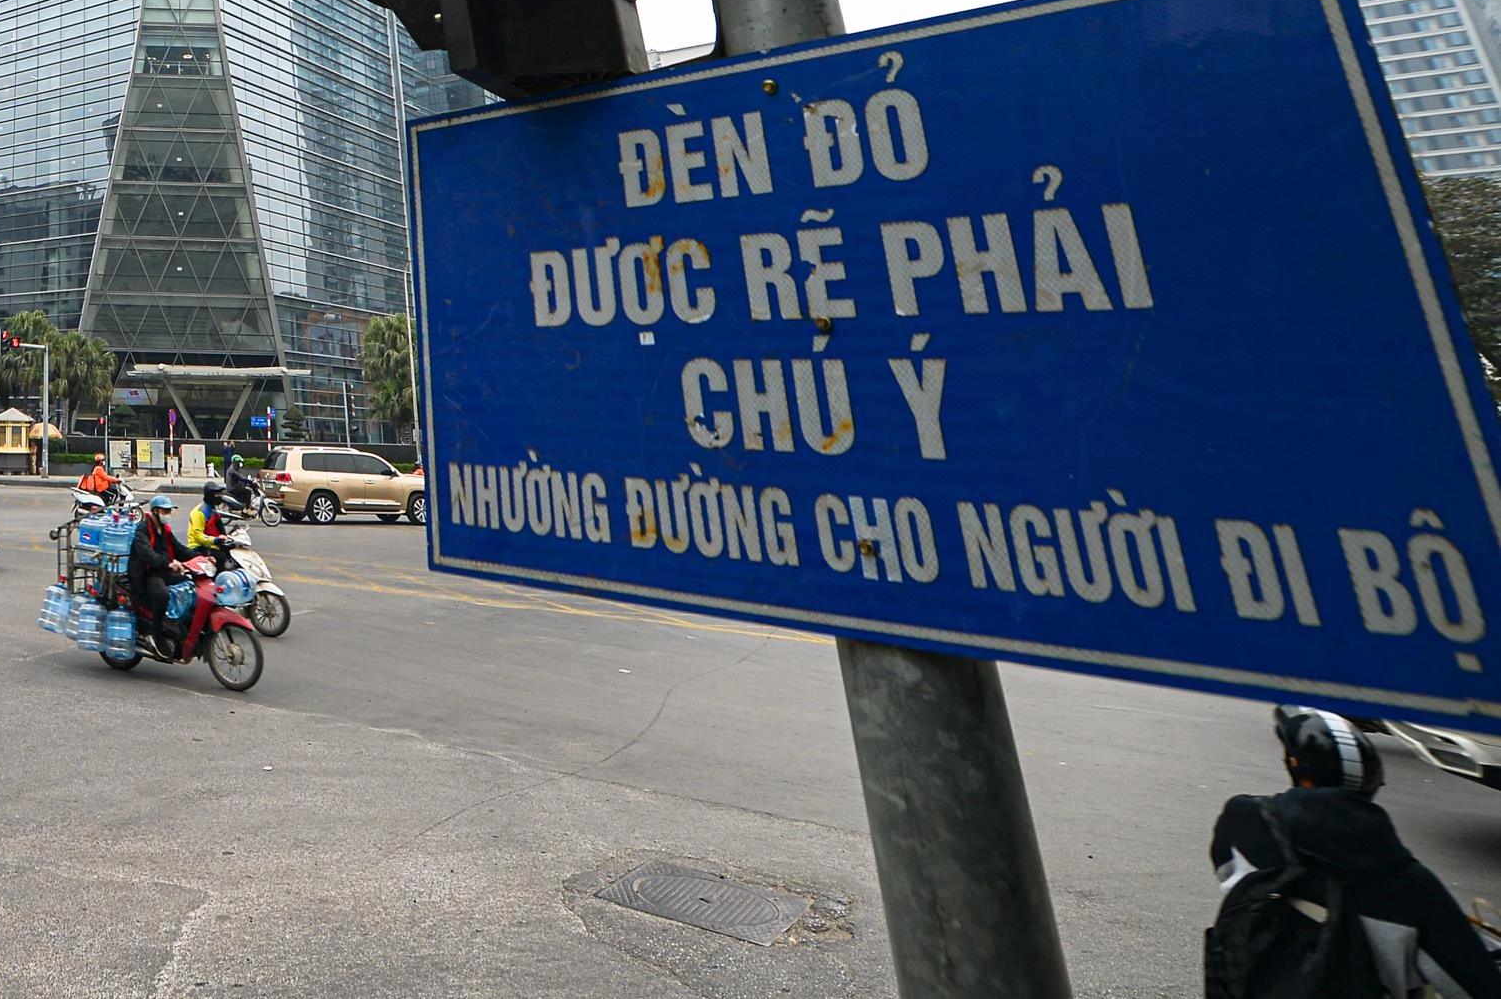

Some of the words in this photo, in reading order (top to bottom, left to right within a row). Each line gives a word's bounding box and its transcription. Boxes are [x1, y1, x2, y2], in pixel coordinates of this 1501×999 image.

[617, 103, 774, 209] ĐÈN
[801, 50, 929, 190] ĐỎ
[528, 232, 717, 346] ĐƯỢC
[740, 207, 857, 321] RẼ
[880, 164, 1154, 318] PHẢI
[680, 334, 856, 457] CHÚ
[889, 332, 948, 461] Ý
[448, 447, 611, 546] NHƯỜNG
[624, 461, 798, 568] ĐƯỜNG
[814, 492, 941, 585] CHO
[956, 488, 1198, 613] NGƯỜI
[1214, 517, 1323, 627] ĐI
[1336, 508, 1487, 675] BỘ
